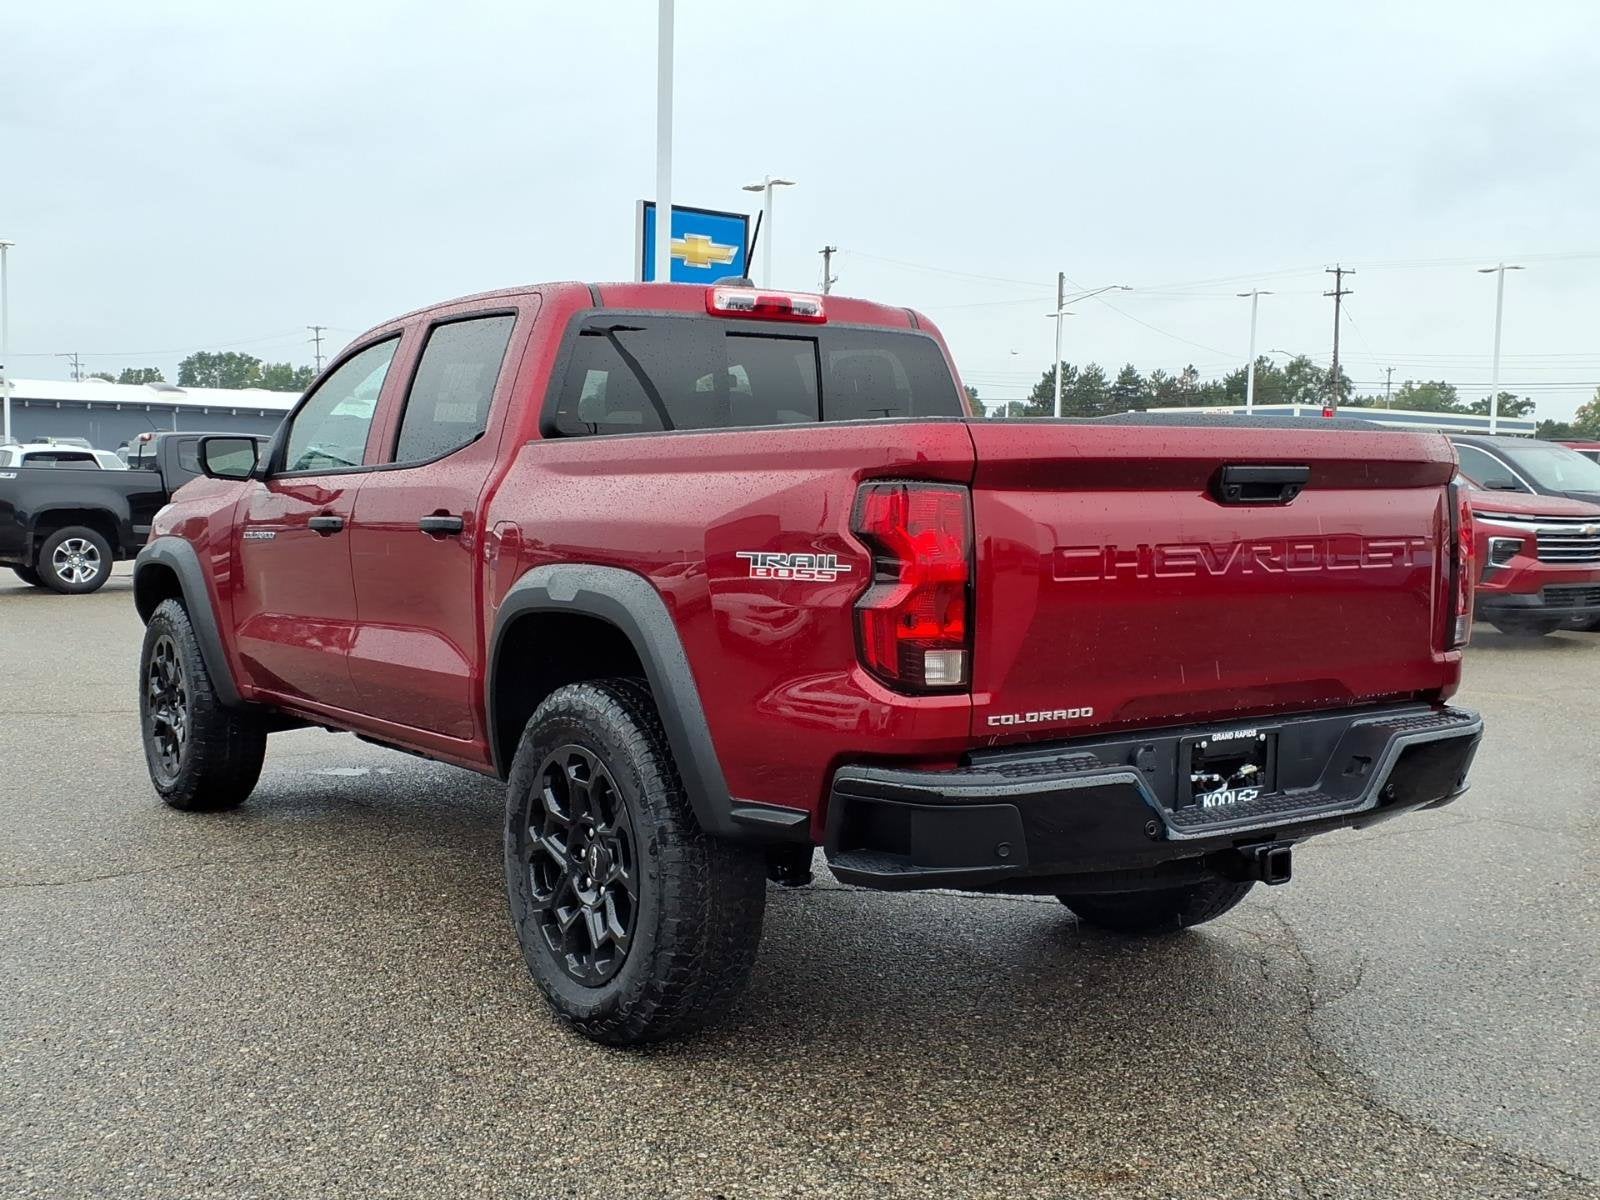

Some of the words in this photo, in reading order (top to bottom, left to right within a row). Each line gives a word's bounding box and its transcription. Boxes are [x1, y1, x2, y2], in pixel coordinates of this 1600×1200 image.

[736, 551, 852, 572] TRAIL
[1053, 540, 1425, 582] CHEVROLET
[749, 567, 837, 582] BOSS
[987, 706, 1094, 726] COLORADO
[1211, 732, 1234, 741] GRAND
[1234, 729, 1257, 739] RAPIDS
